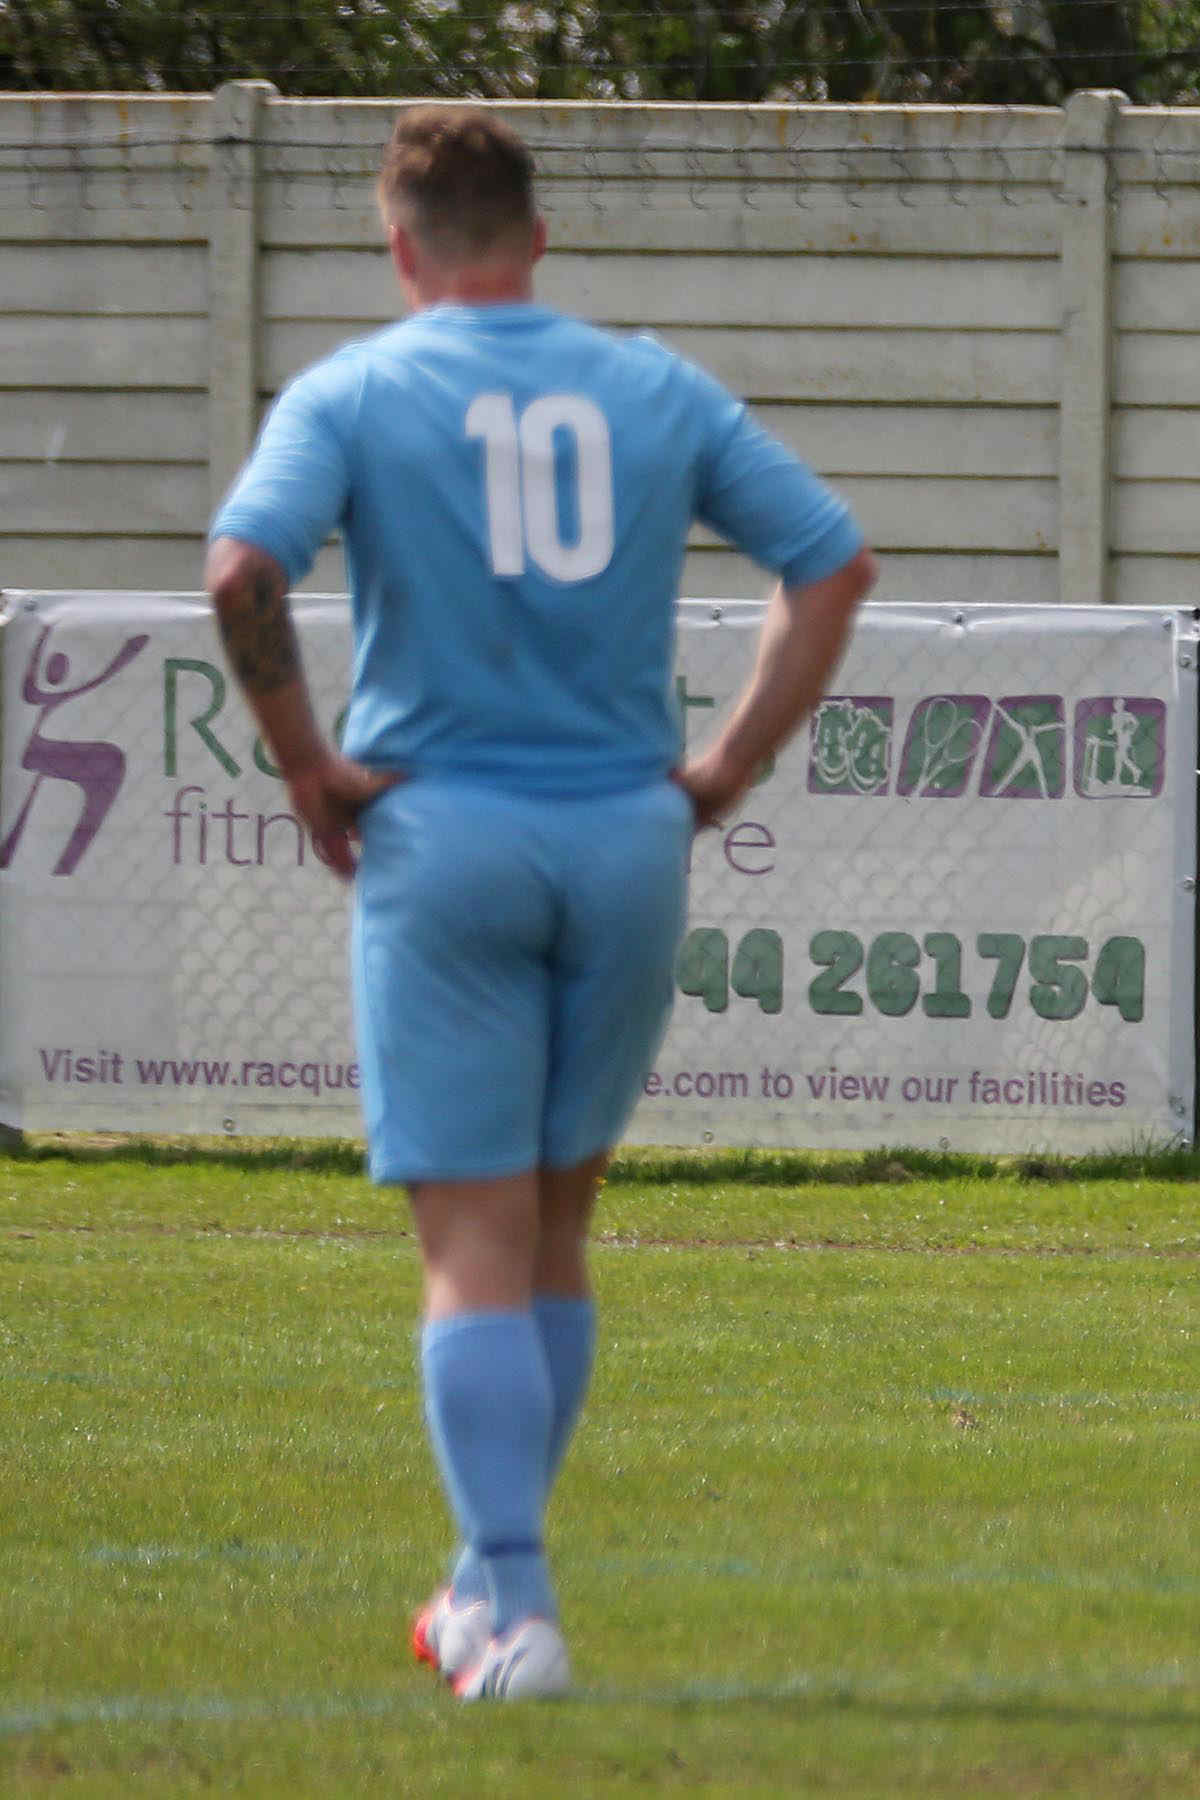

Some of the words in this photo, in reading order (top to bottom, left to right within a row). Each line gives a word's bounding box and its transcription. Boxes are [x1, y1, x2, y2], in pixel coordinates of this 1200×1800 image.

[465, 394, 616, 582] 10
[164, 785, 305, 866] fitn
[808, 929, 1146, 1023] 261754
[39, 1048, 124, 1084] Visit
[760, 1065, 794, 1099] to
[806, 1065, 890, 1101] view
[902, 1074, 960, 1103] our
[968, 1069, 1127, 1108] facilities
